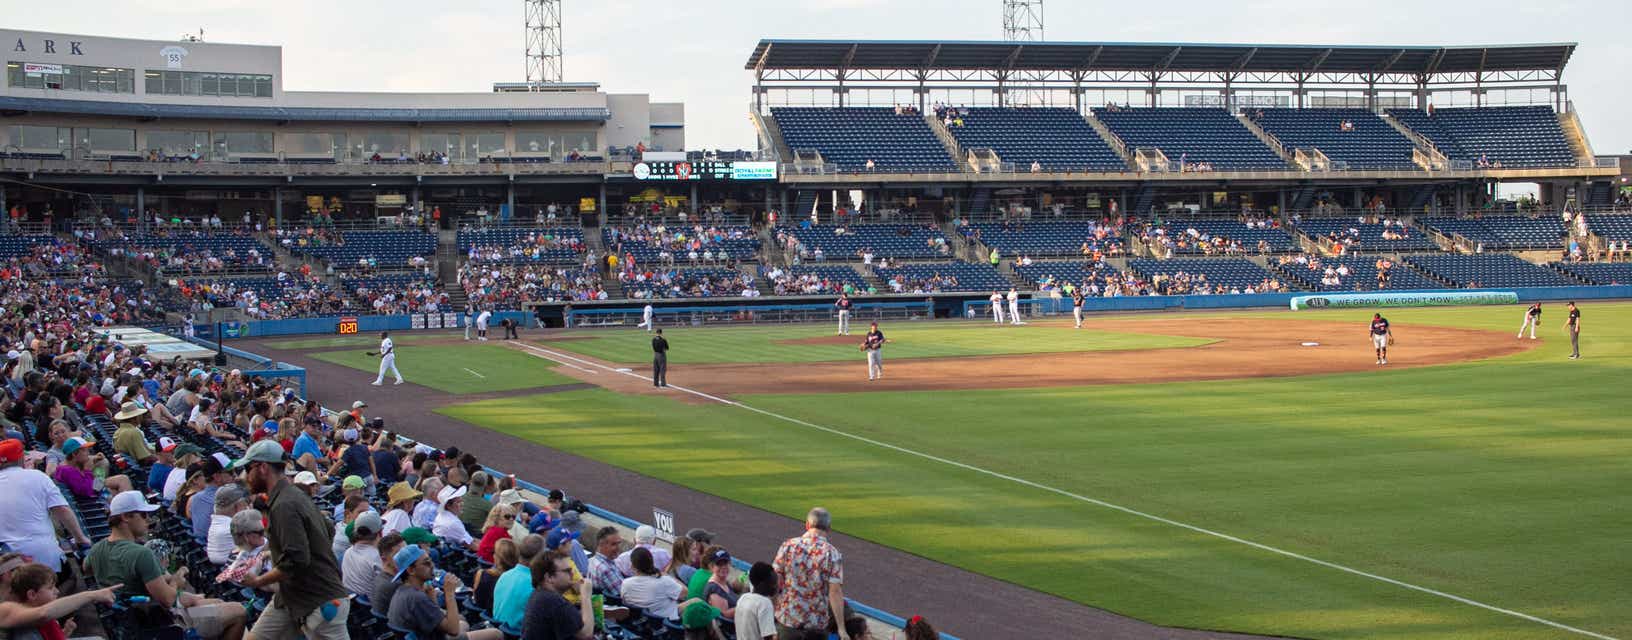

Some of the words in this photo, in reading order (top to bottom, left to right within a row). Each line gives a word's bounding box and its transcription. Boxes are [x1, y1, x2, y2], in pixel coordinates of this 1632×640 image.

[169, 53, 180, 62] 55
[1385, 297, 1398, 305] WE
[653, 511, 673, 533] YOU
